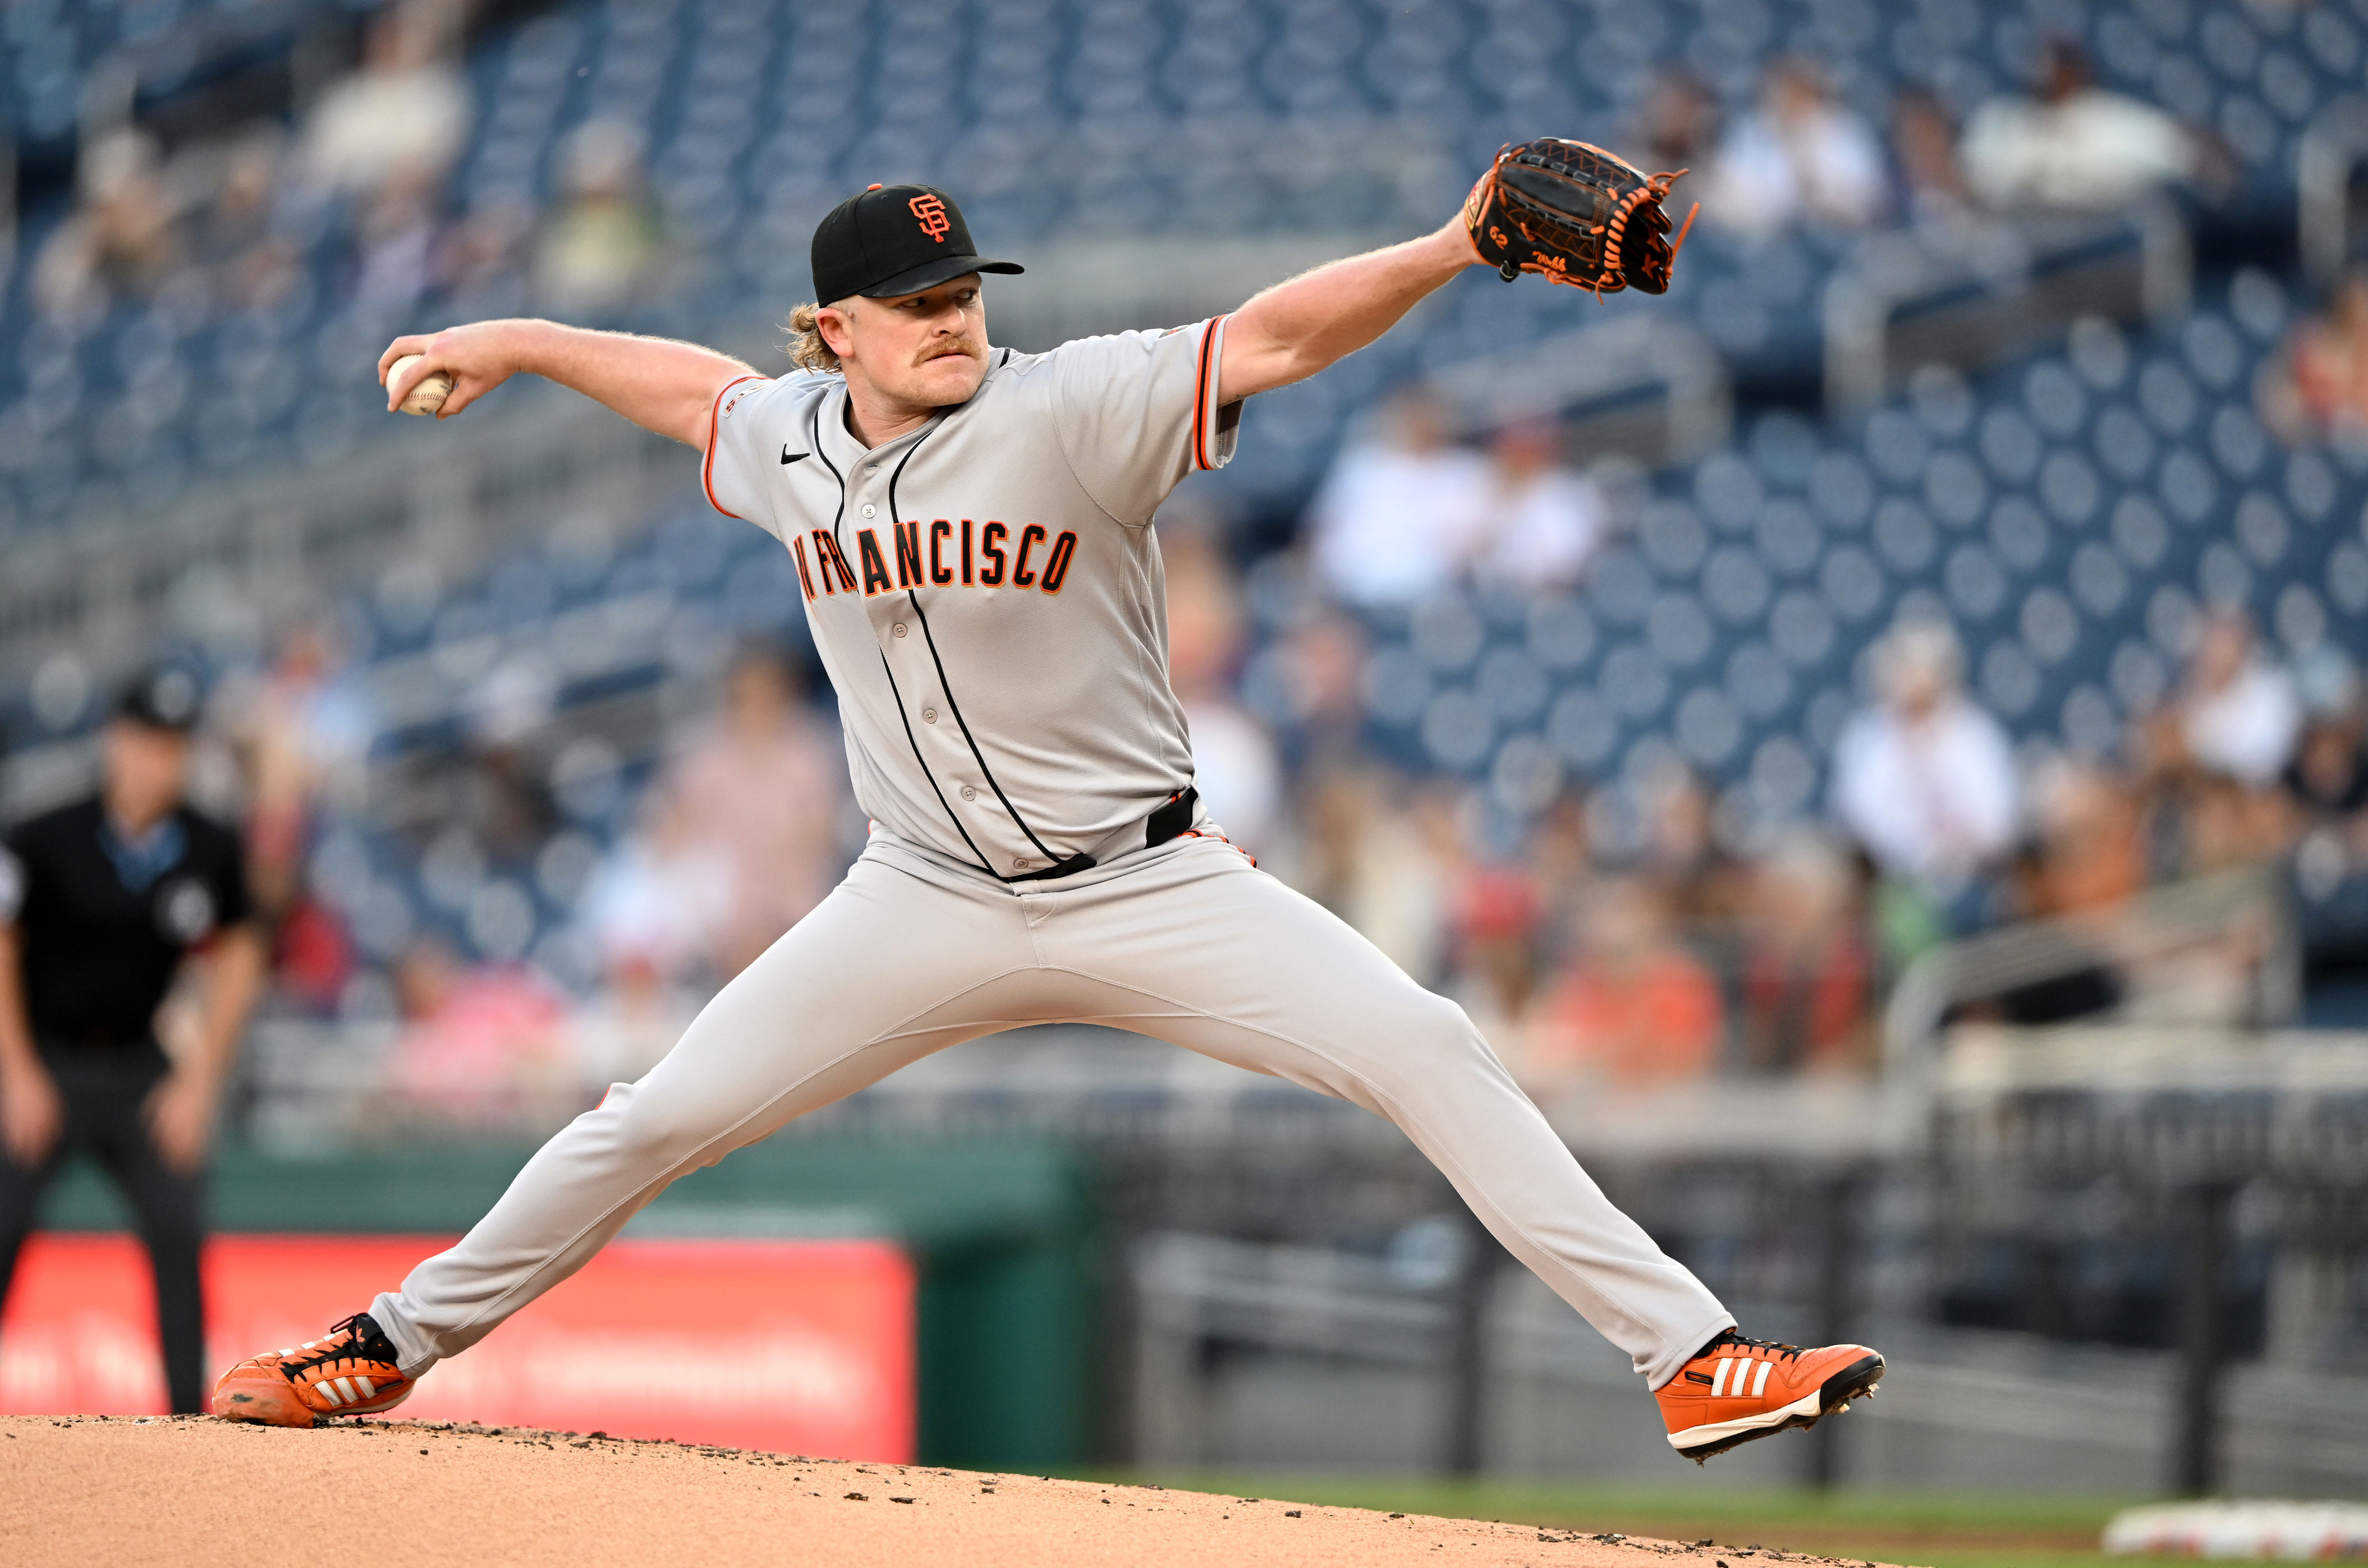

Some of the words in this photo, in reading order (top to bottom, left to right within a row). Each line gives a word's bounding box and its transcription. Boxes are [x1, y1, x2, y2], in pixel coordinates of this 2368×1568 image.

[908, 194, 951, 243] SF
[1489, 226, 1508, 250] 62
[791, 534, 818, 606] N
[811, 519, 1079, 597] FRANCISCO
